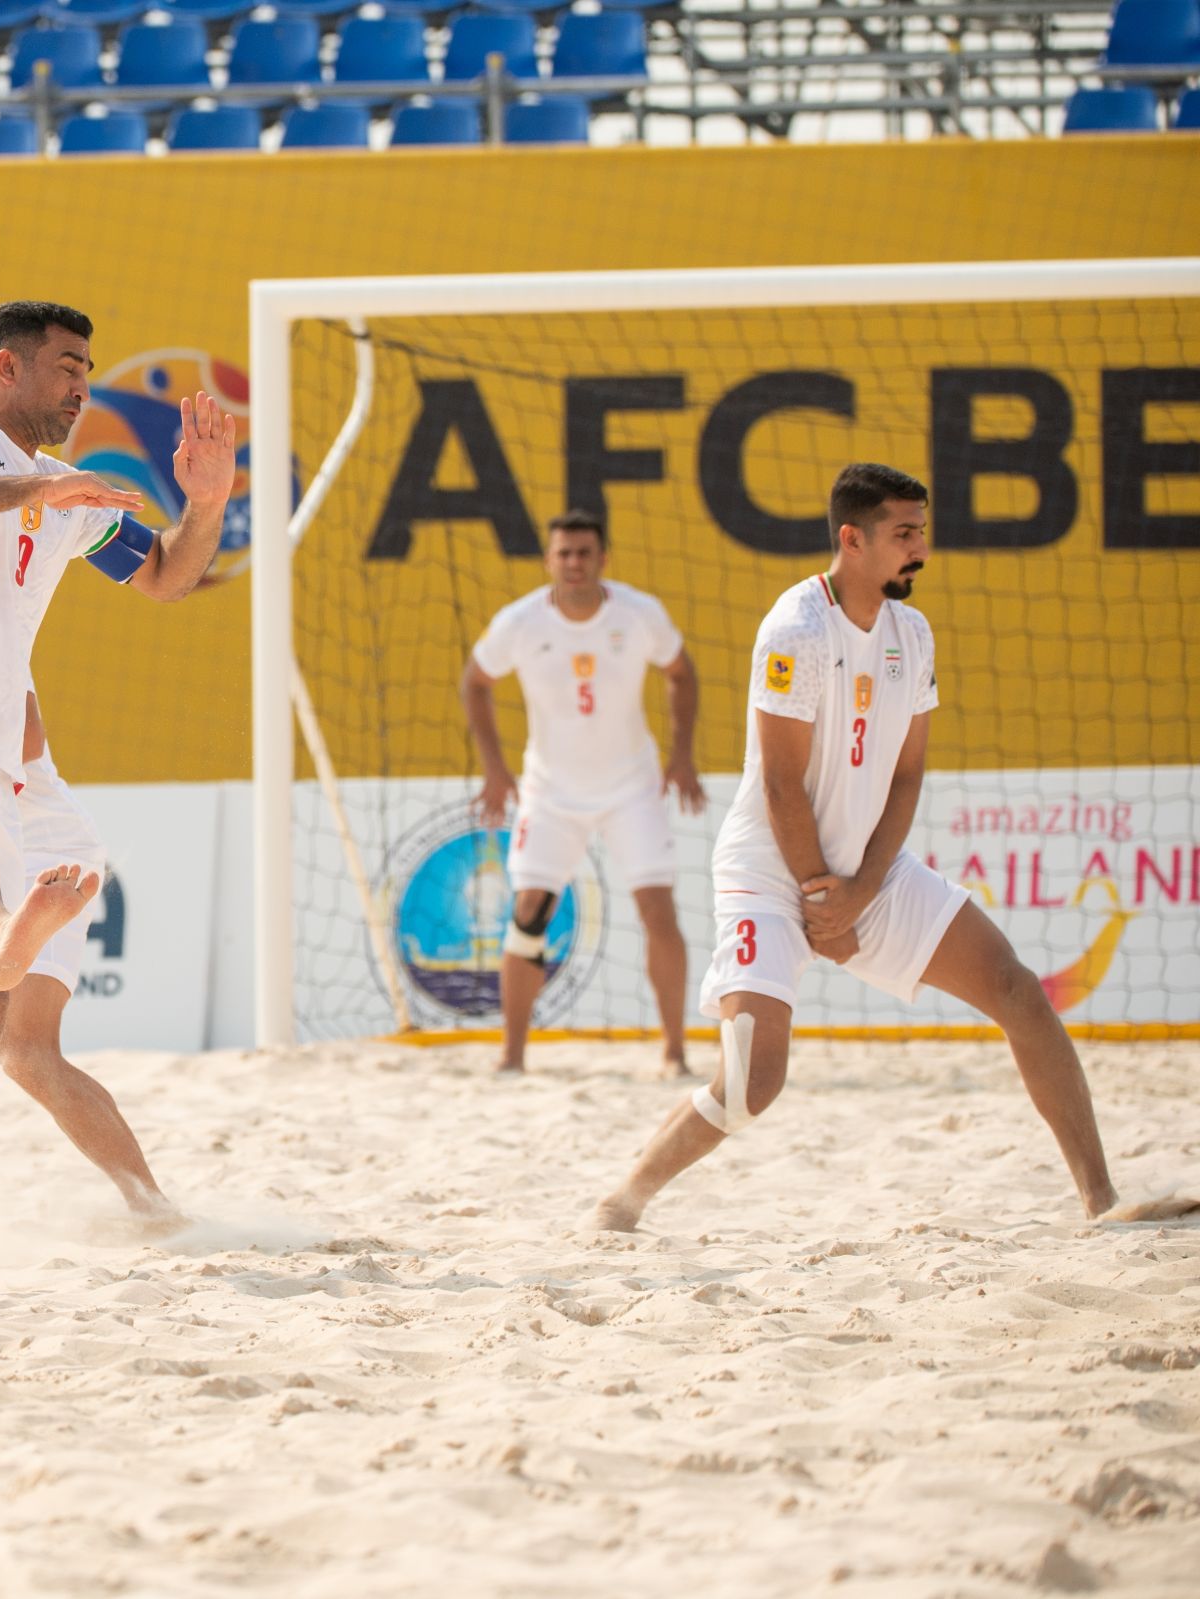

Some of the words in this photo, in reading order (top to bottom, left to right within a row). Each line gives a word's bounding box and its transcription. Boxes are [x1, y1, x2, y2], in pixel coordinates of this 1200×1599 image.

[365, 368, 858, 560] AFC
[928, 367, 1200, 551] BE
[577, 682, 595, 716] 5
[851, 717, 867, 767] 3
[950, 794, 1134, 843] amazing
[926, 845, 1200, 909] AILAN
[736, 918, 757, 966] 3
